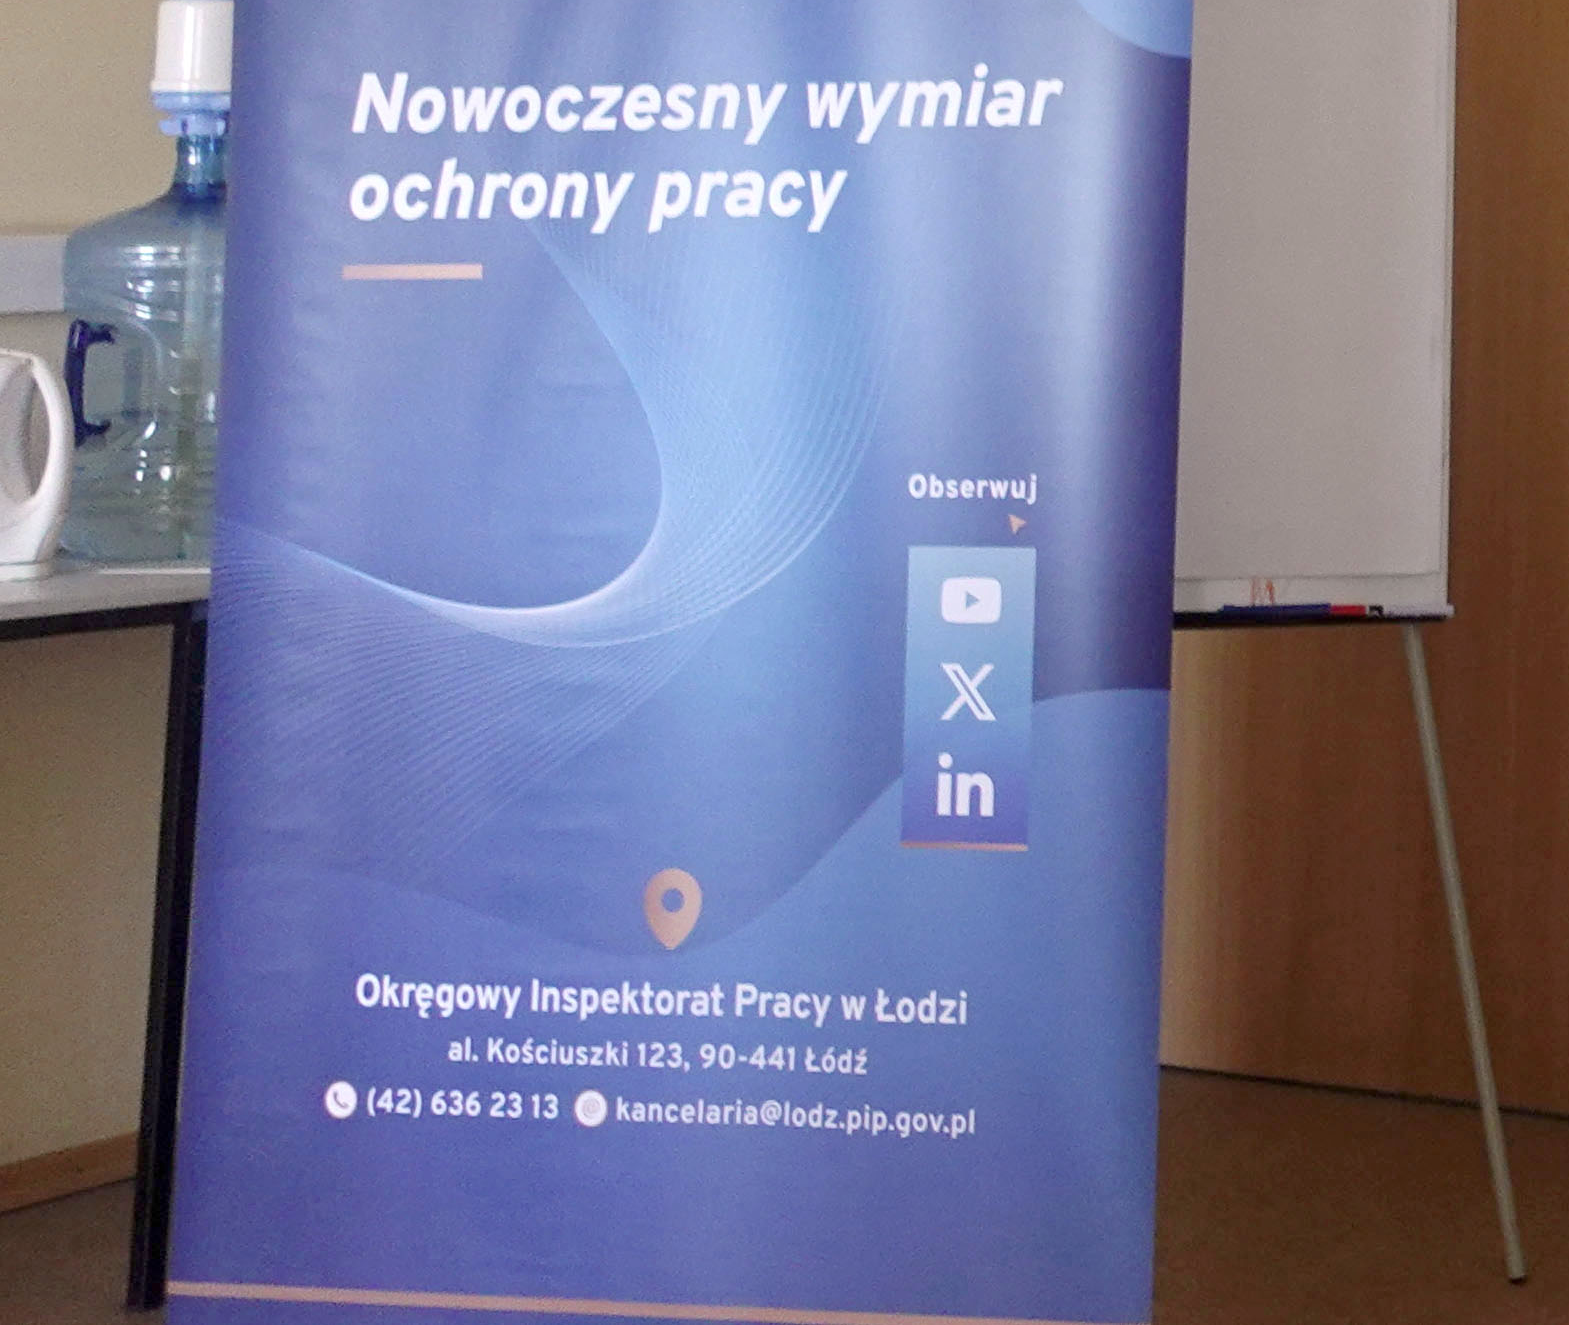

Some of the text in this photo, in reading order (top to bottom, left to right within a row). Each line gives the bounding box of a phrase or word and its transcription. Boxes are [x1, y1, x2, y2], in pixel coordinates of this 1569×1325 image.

[352, 65, 1062, 144] Nowoczesny wymiar
[349, 158, 846, 234] ochrony pracy
[909, 472, 1036, 504] Obserwuj
[354, 973, 968, 1028] Okręgowy Inspektorat Pracy w Łodzi
[447, 1034, 868, 1077] al. Kościuszki 123, 90-441 Łódź
[366, 1087, 976, 1137] (42) 636 23 13 kancelaria@lodz.pip.gov.pl
